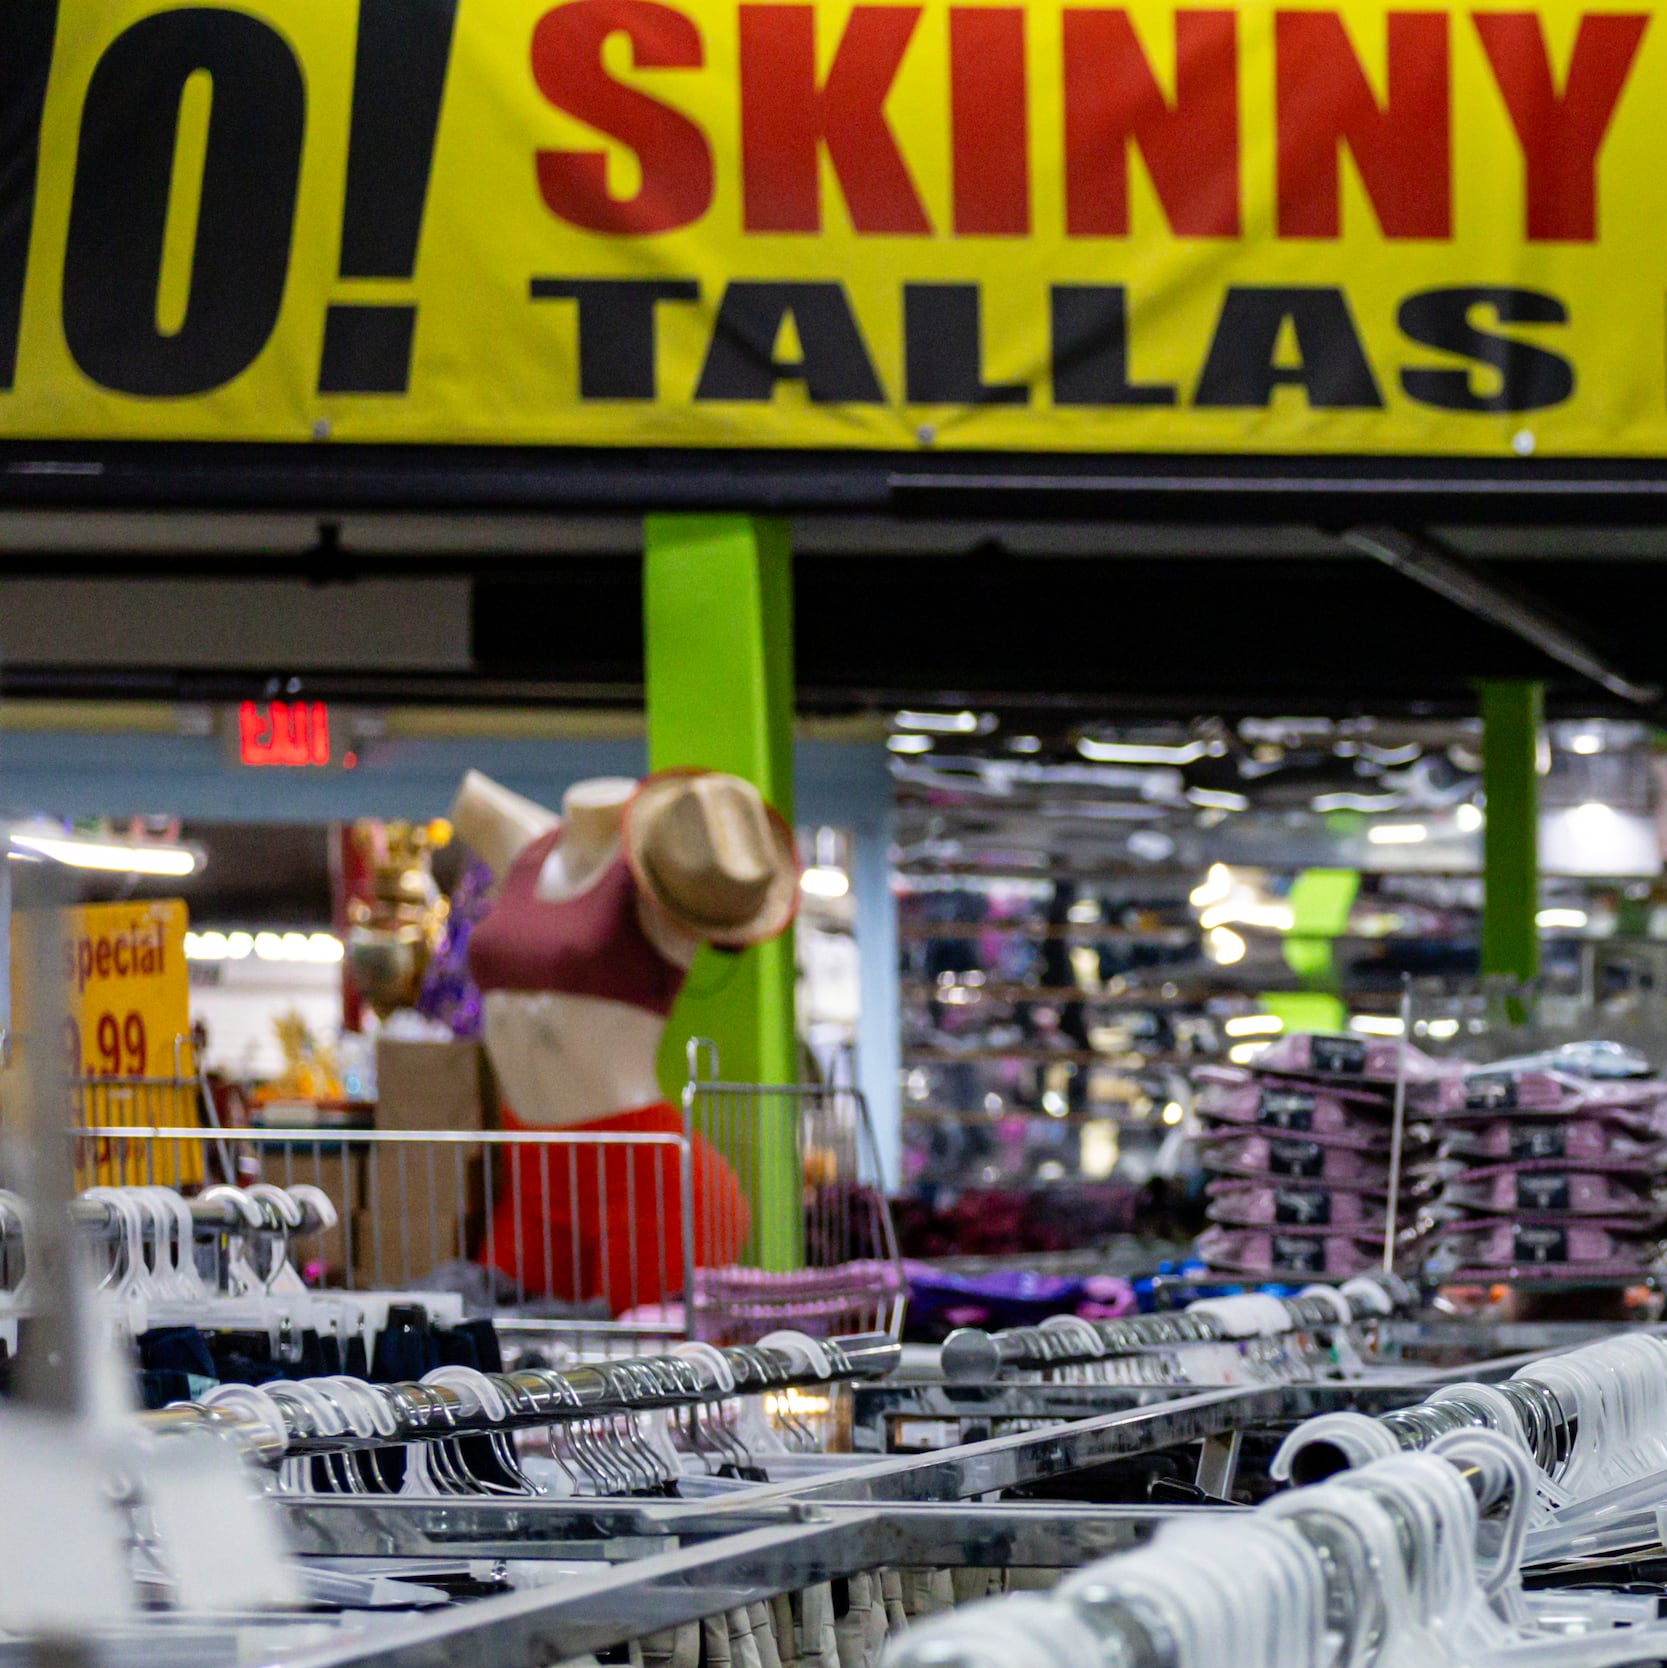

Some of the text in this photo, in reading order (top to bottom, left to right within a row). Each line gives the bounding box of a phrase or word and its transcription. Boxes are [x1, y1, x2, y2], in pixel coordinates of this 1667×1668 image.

[0, 0, 458, 400] O!
[530, 0, 1650, 243] SKINNY
[529, 278, 1577, 415] TALLAS
[64, 921, 165, 993] special
